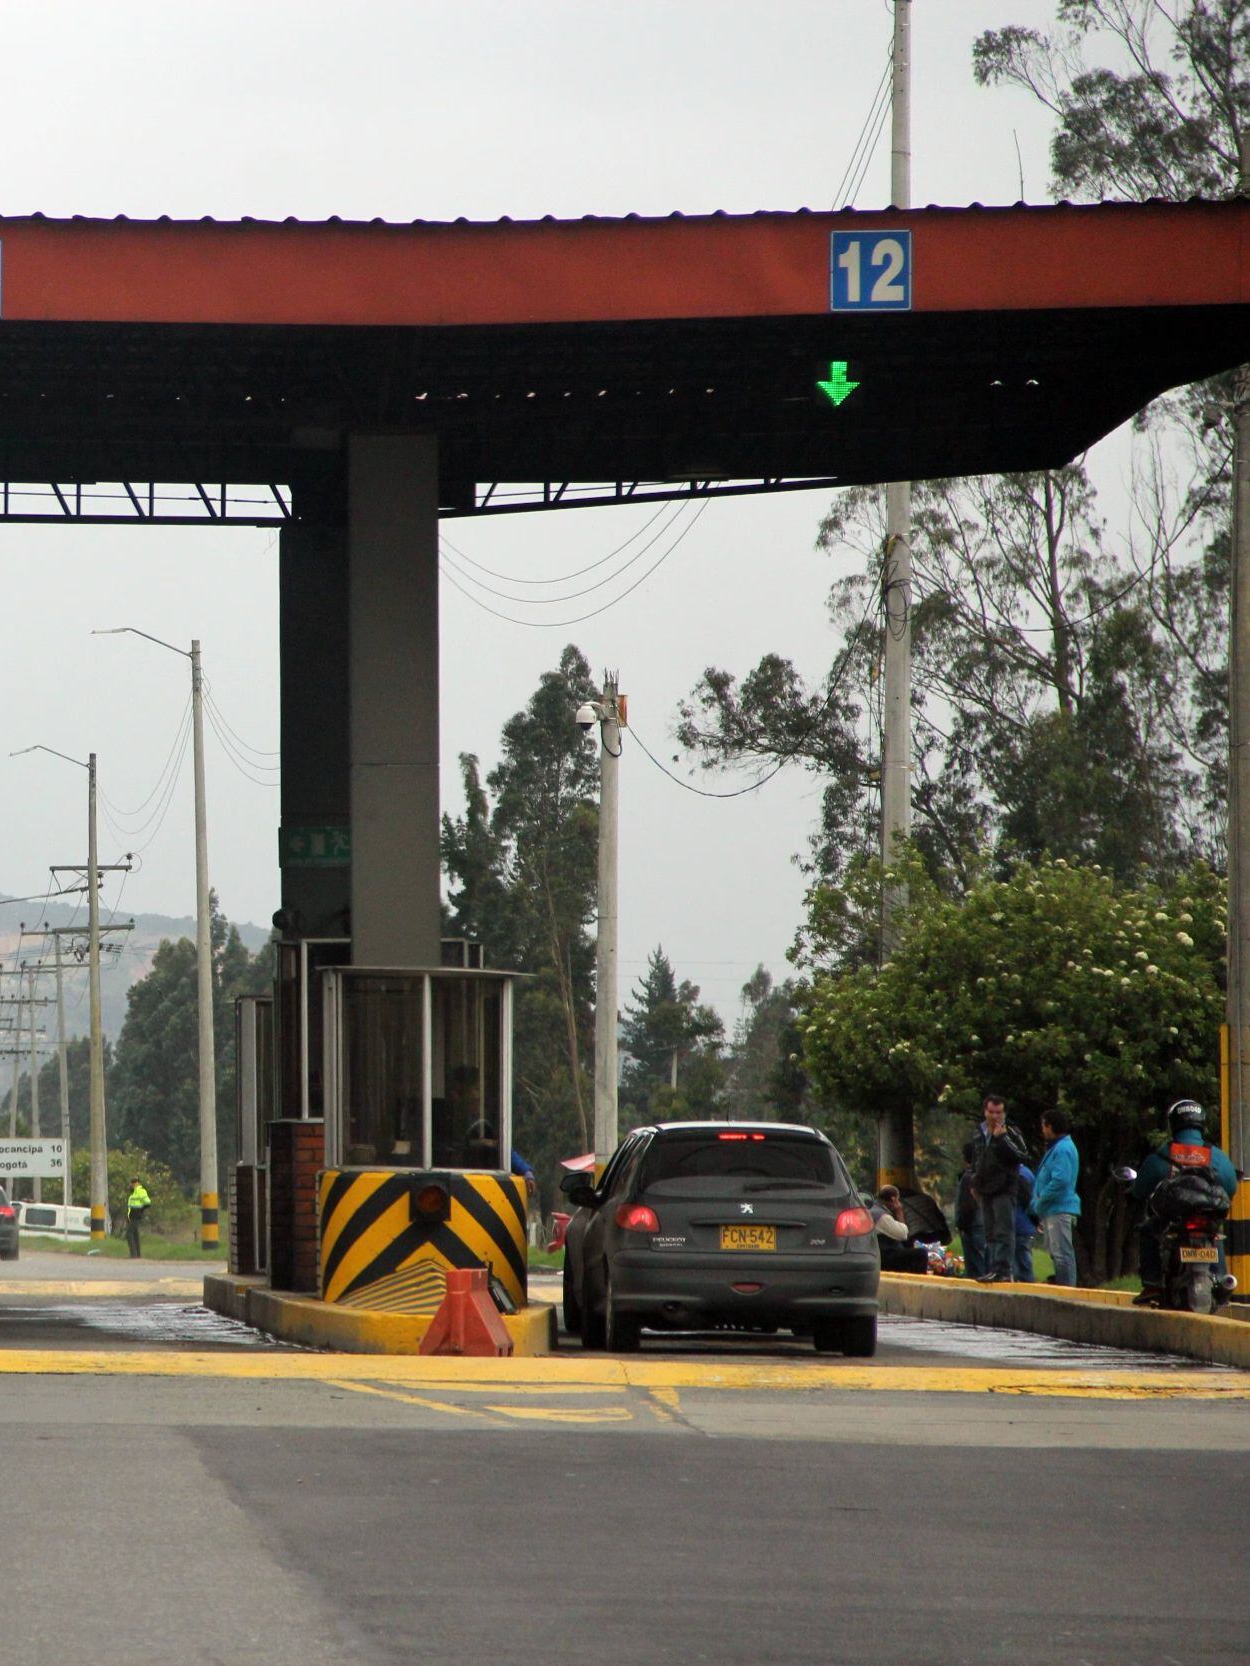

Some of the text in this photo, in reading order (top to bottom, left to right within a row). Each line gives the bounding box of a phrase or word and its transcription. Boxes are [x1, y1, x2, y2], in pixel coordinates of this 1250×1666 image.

[838, 238, 905, 302] 12
[51, 1144, 63, 1154] 10
[50, 1159, 63, 1168] 36
